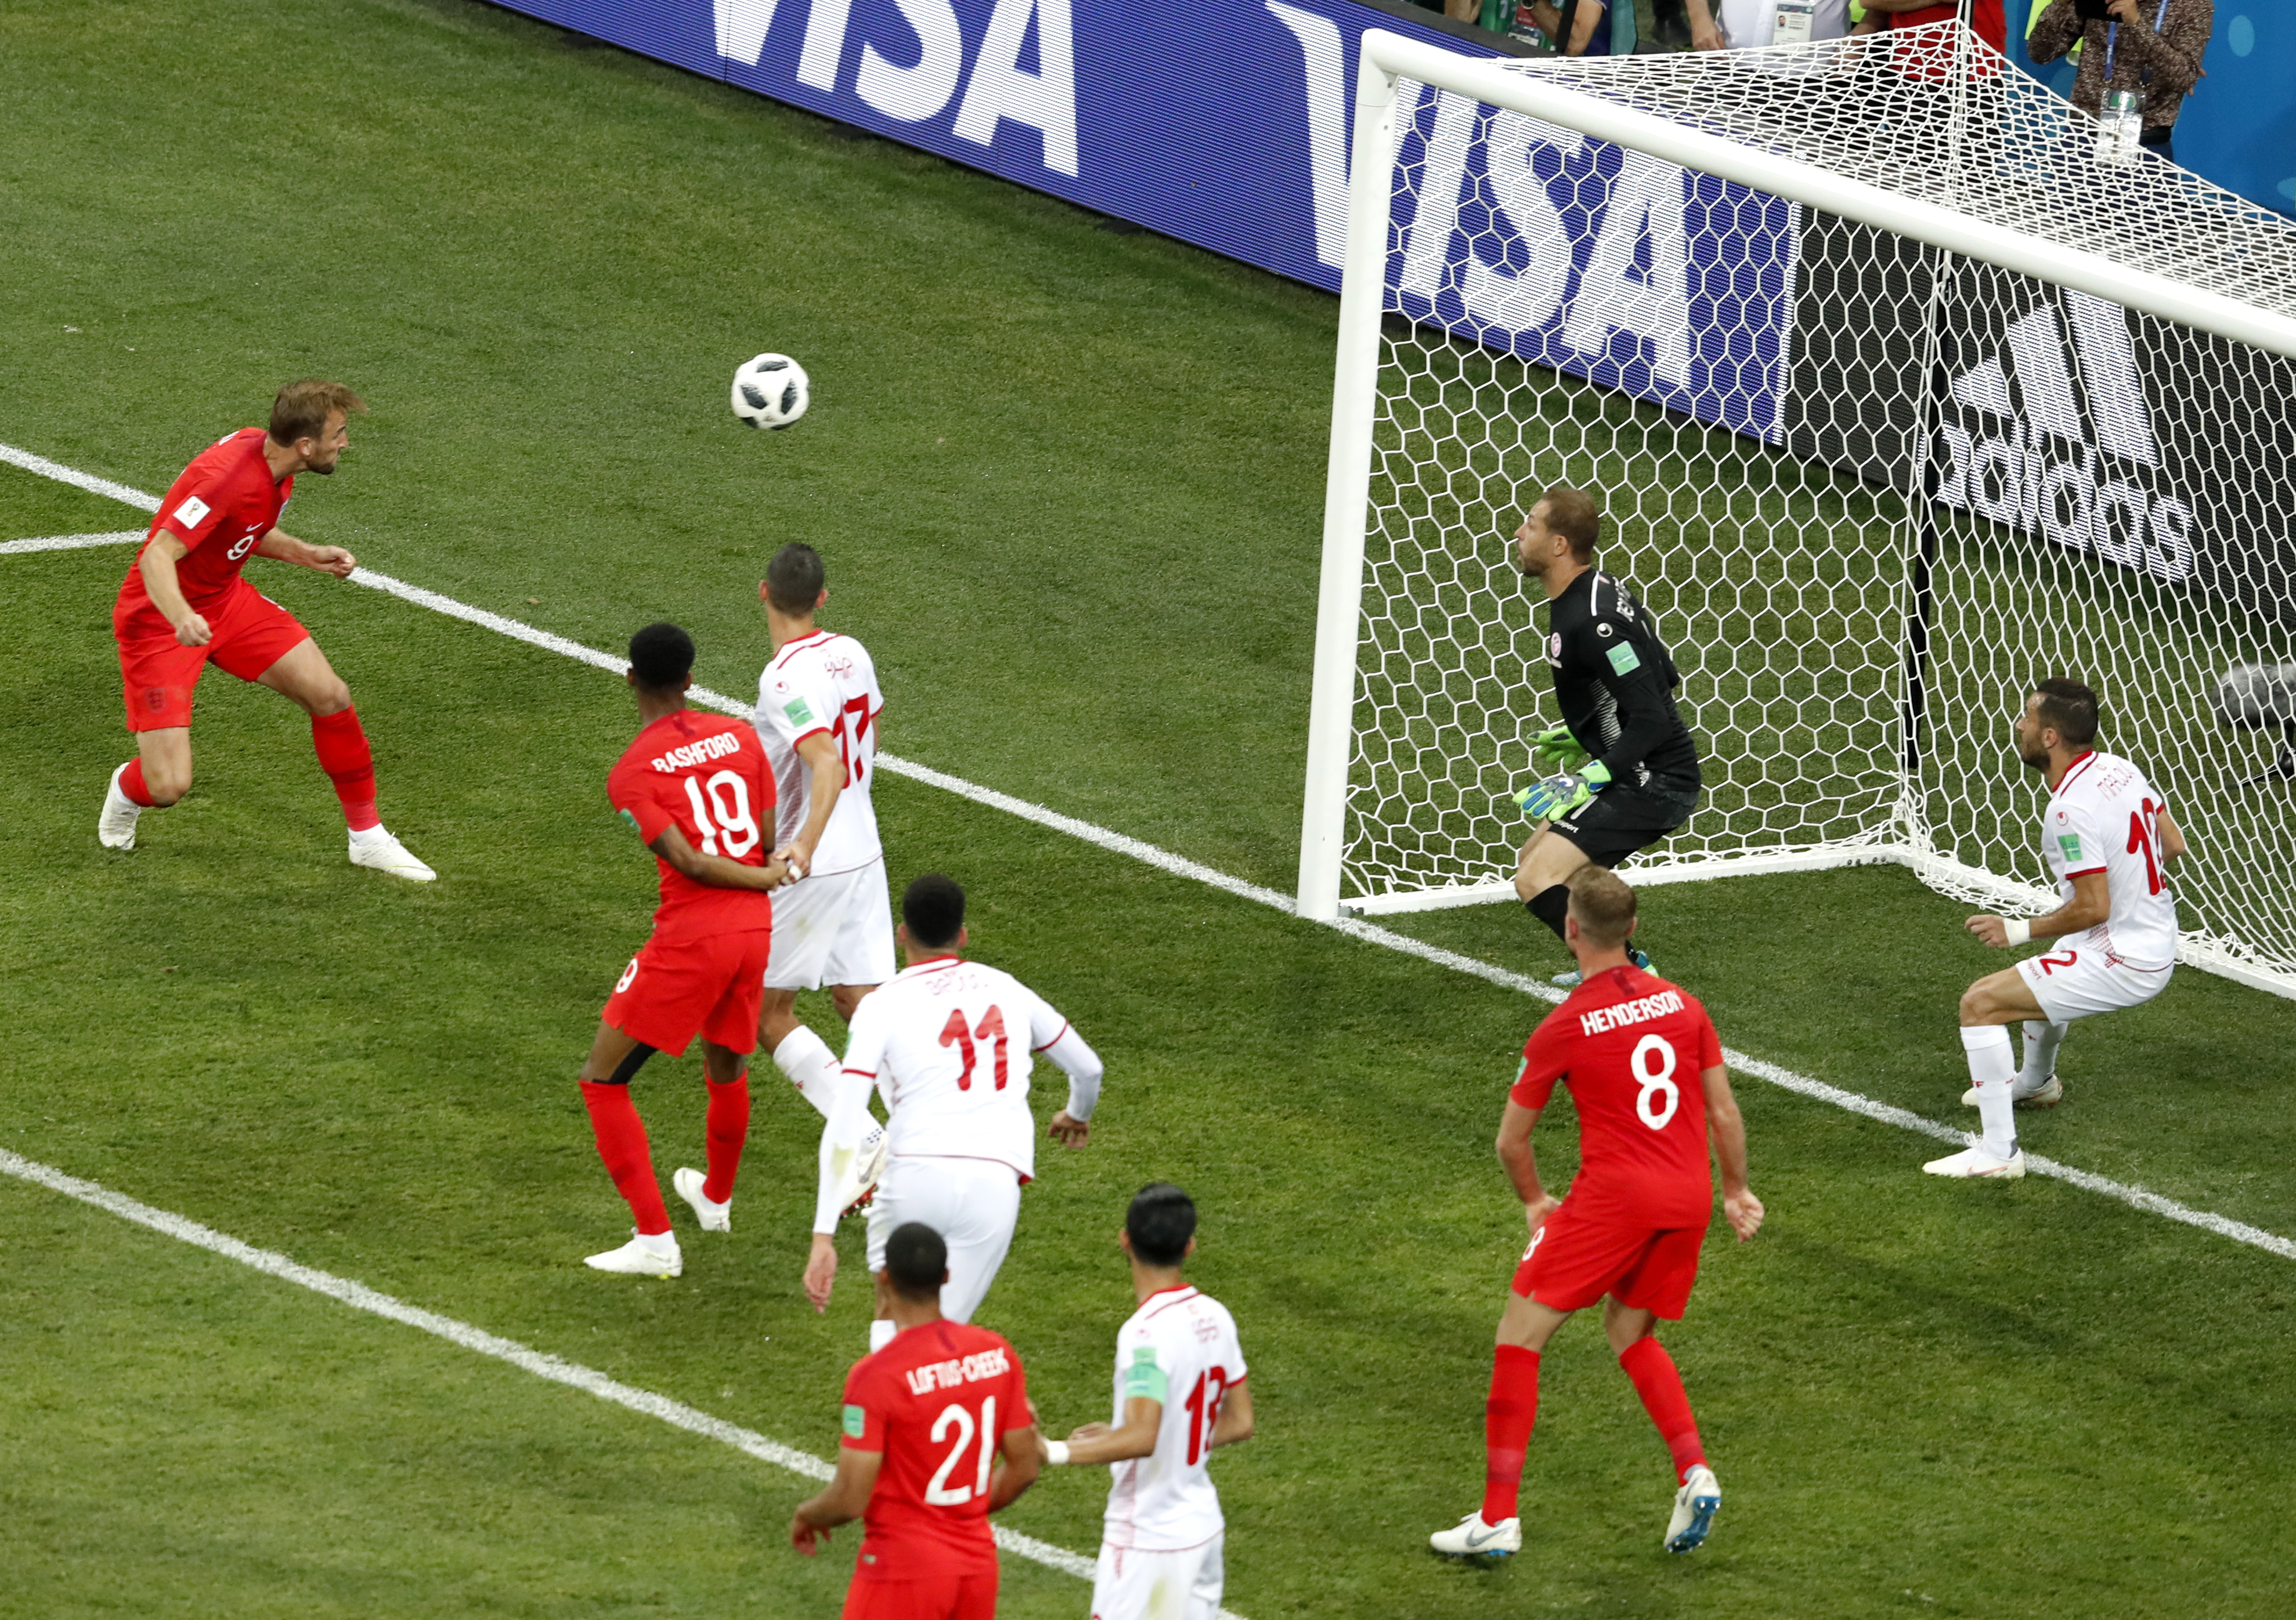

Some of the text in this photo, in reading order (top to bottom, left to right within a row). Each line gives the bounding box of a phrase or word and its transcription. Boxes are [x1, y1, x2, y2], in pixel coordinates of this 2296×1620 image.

[713, 0, 1078, 177] SA
[1264, 1, 1691, 388] VISA
[1917, 417, 2193, 583] adidas
[227, 535, 254, 561] 9
[651, 732, 741, 773] RASHFORD
[832, 693, 870, 789] 17
[684, 770, 759, 857] 19
[2037, 950, 2077, 976] 2
[938, 1004, 1008, 1091] 11
[1580, 989, 1685, 1037] HENDERSON
[1630, 1034, 1680, 1130] 8
[1522, 1226, 1546, 1261] 8
[924, 1395, 996, 1506] 21
